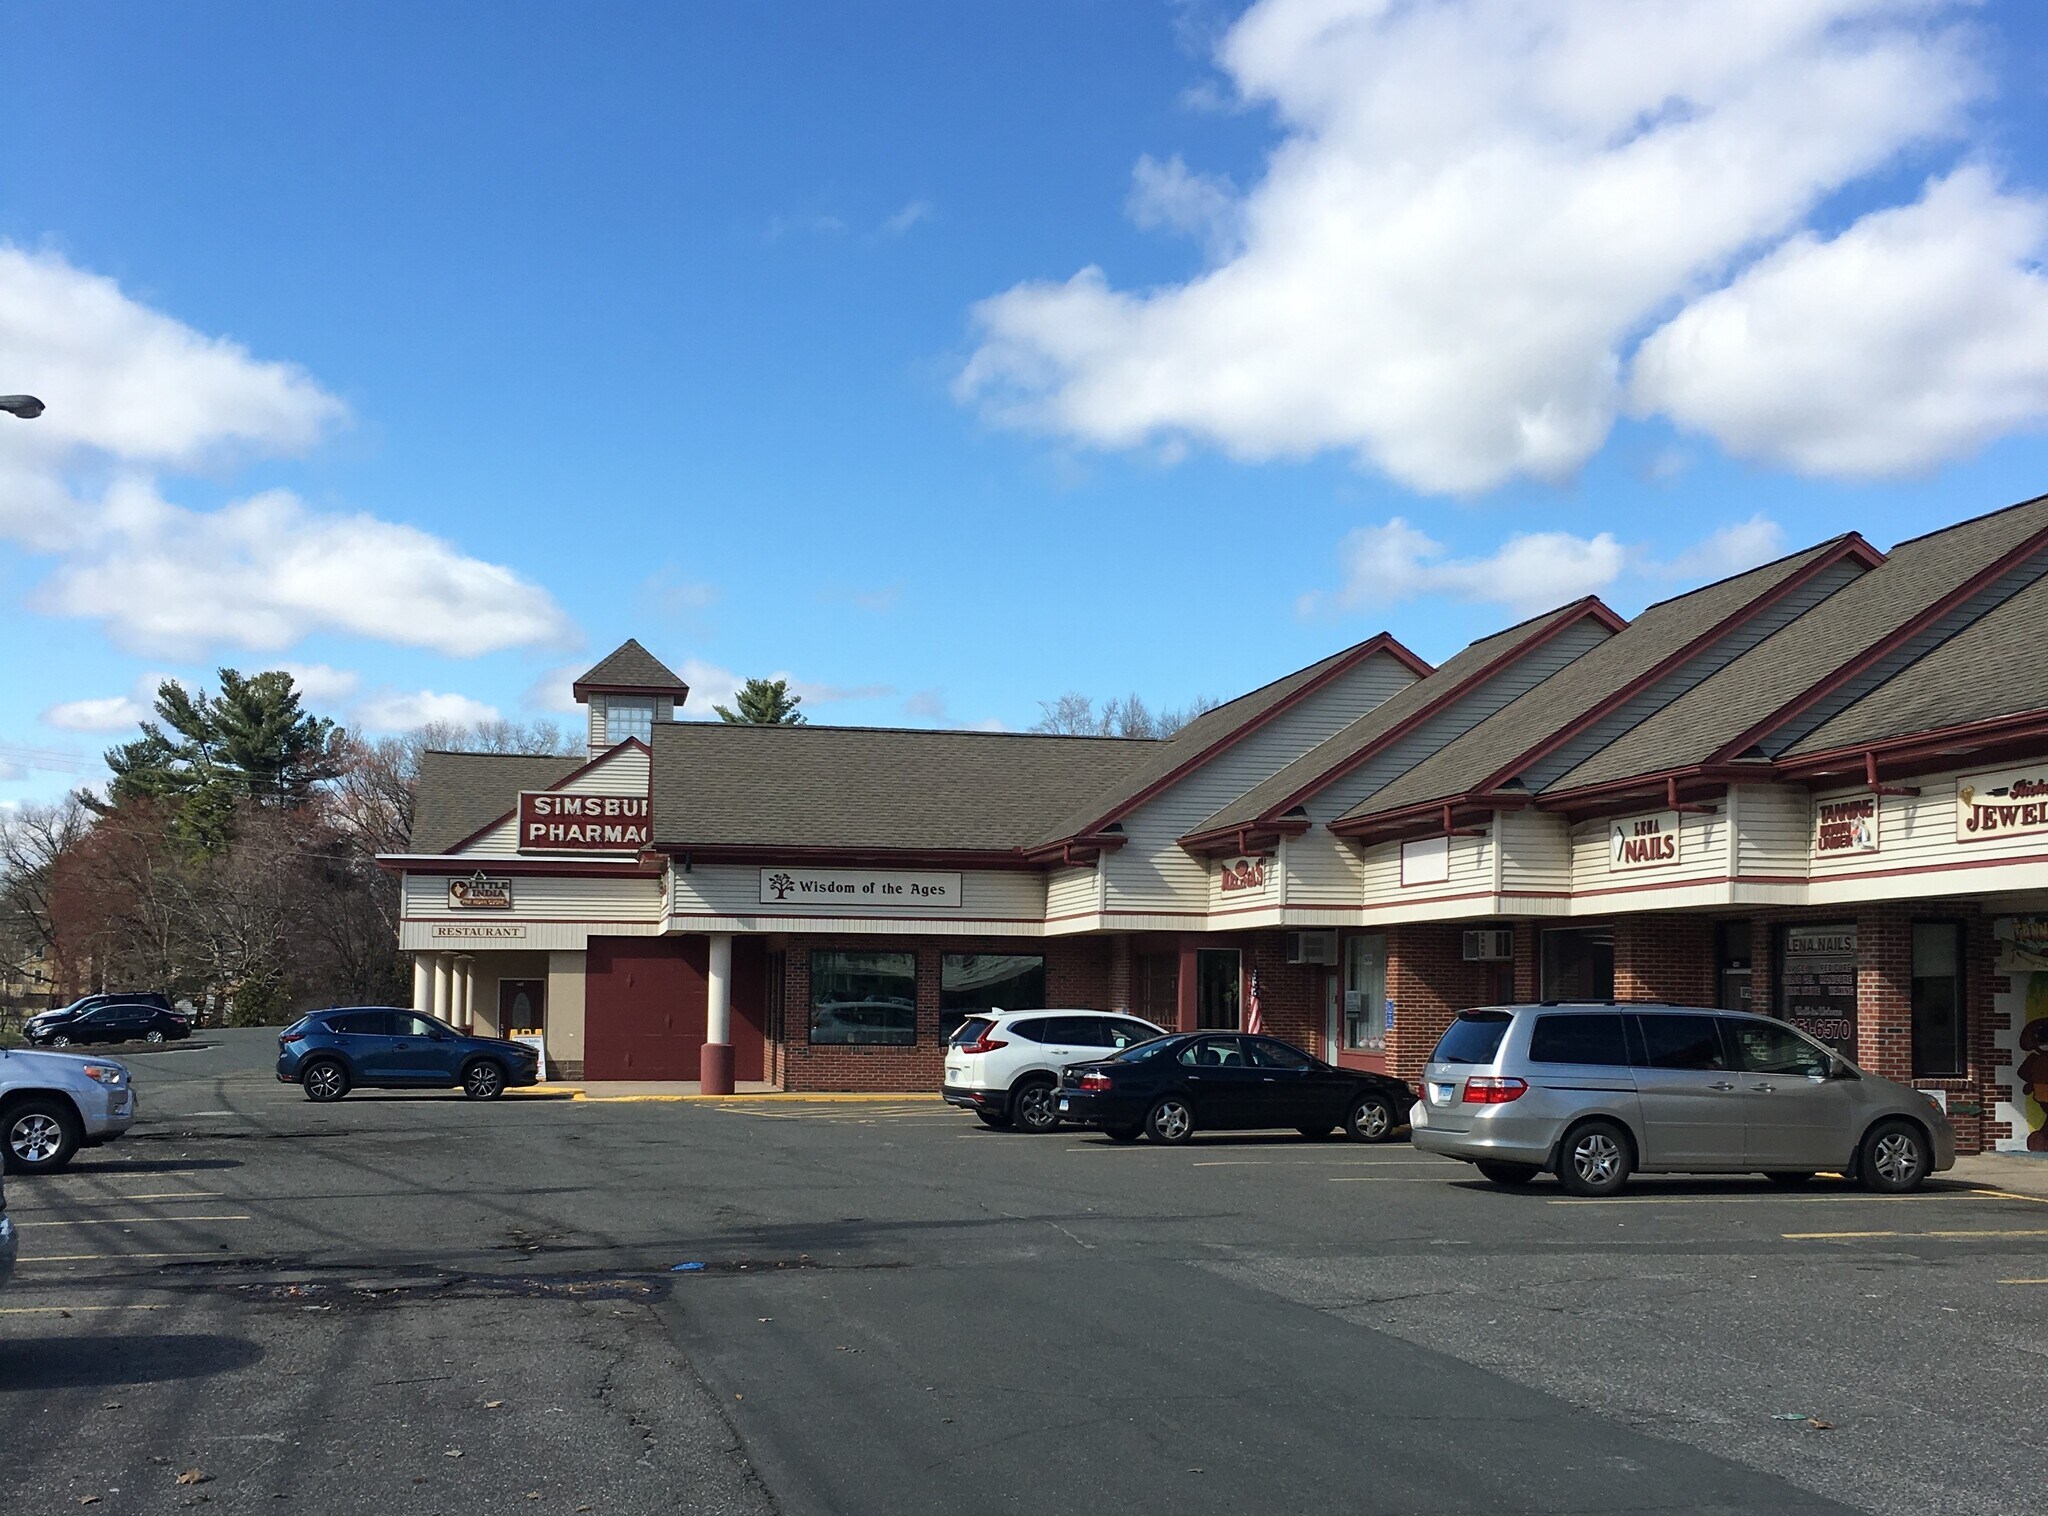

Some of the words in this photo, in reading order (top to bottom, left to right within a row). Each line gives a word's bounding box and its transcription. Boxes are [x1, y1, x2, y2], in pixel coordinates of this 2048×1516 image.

[1820, 799, 1874, 824] TANNING
[1634, 819, 1660, 837] LENA
[1624, 834, 1675, 864] NAILS
[468, 881, 509, 890] LITTLE
[472, 889, 506, 897] INDIA
[799, 880, 855, 894] Wisdom
[862, 882, 875, 894] of
[882, 883, 903, 895] the
[910, 883, 946, 897] Ages
[438, 927, 520, 936] RESTAURANT
[1786, 938, 1815, 953] LENA
[1817, 936, 1852, 951] NAILS
